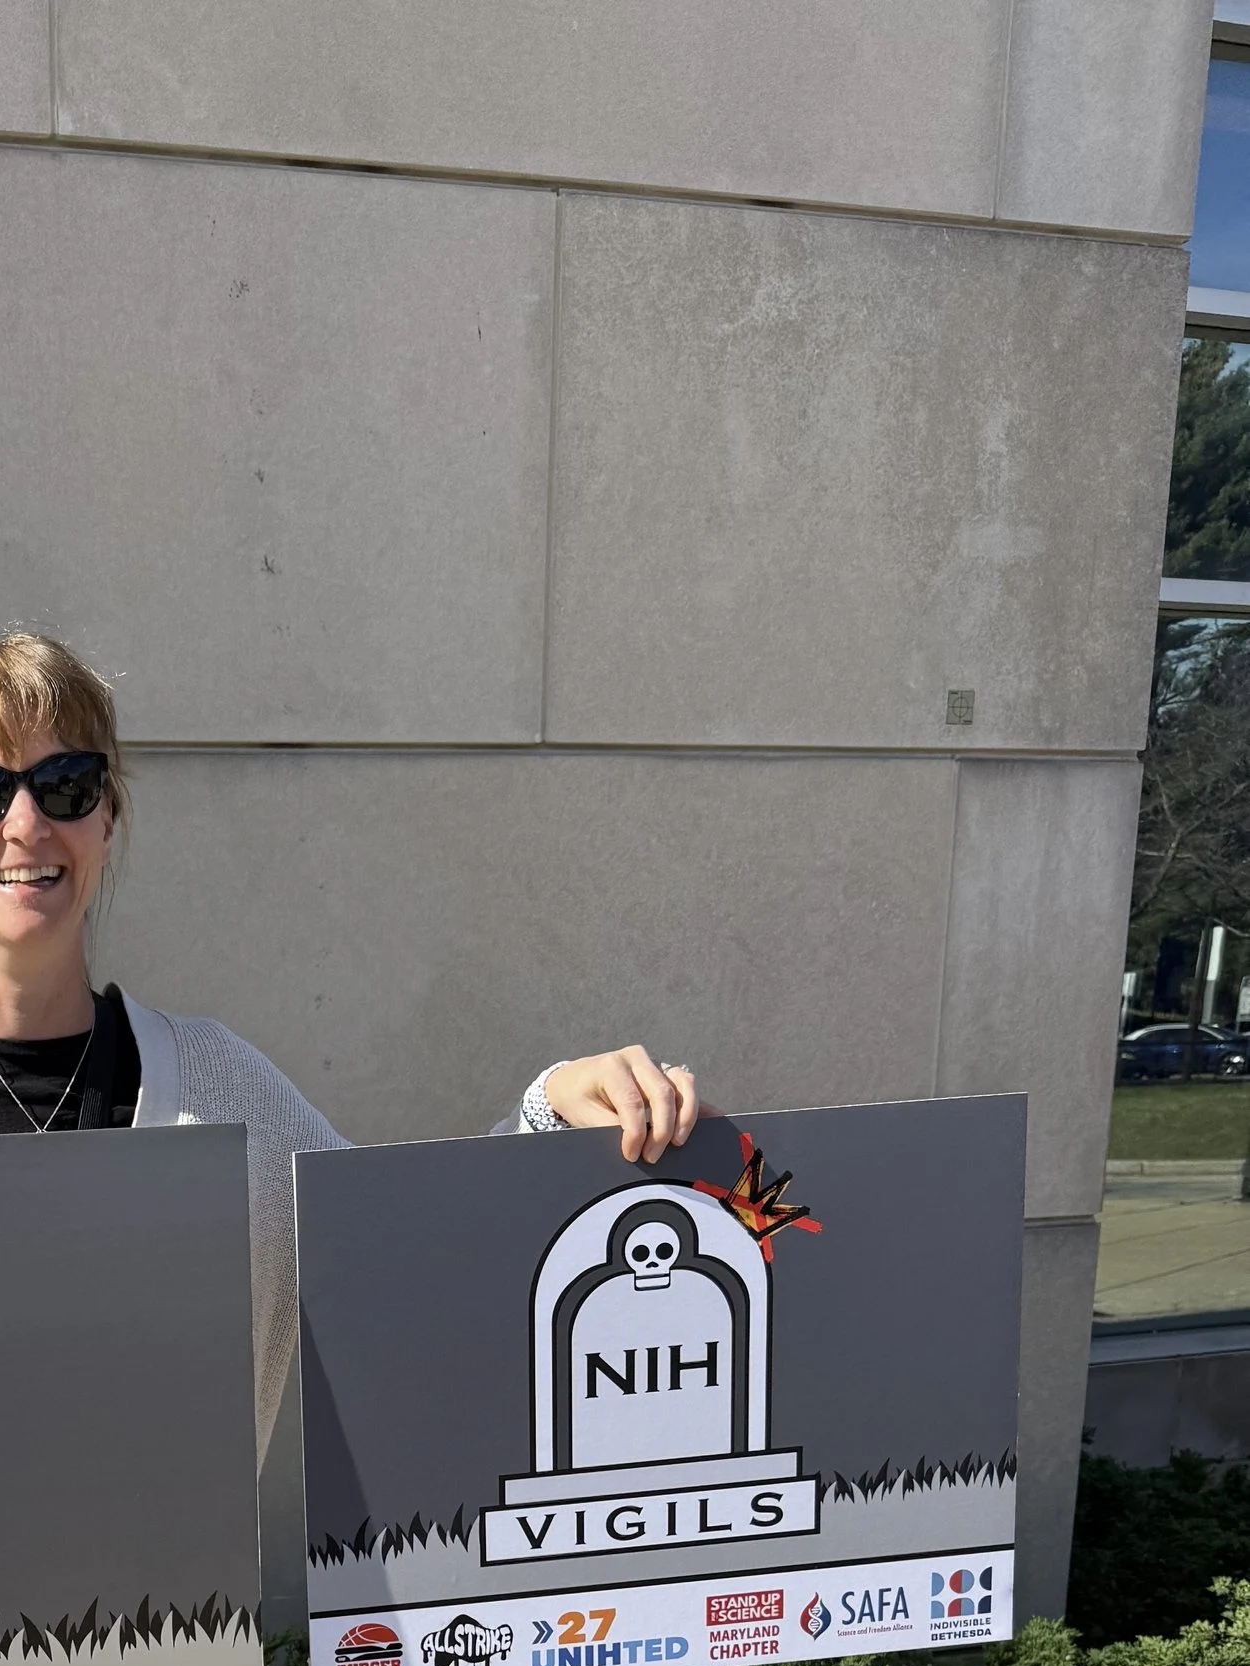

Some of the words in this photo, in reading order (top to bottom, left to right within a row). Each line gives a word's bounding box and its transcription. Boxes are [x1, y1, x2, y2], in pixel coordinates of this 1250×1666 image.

[584, 1340, 720, 1399] NIH
[516, 1492, 784, 1550] VIGILS
[710, 1595, 758, 1611] STAND
[761, 1592, 781, 1606] UP
[841, 1586, 910, 1625] SAFA
[718, 1605, 779, 1622] SCIENCE
[557, 1607, 617, 1644] 27
[837, 1629, 856, 1637] Science
[857, 1626, 868, 1635] and
[930, 1617, 992, 1631] INDIVISIBLE
[710, 1625, 780, 1643] MARYLAND
[931, 1628, 992, 1641] BETHESDA
[710, 1640, 779, 1660] CHAPTER
